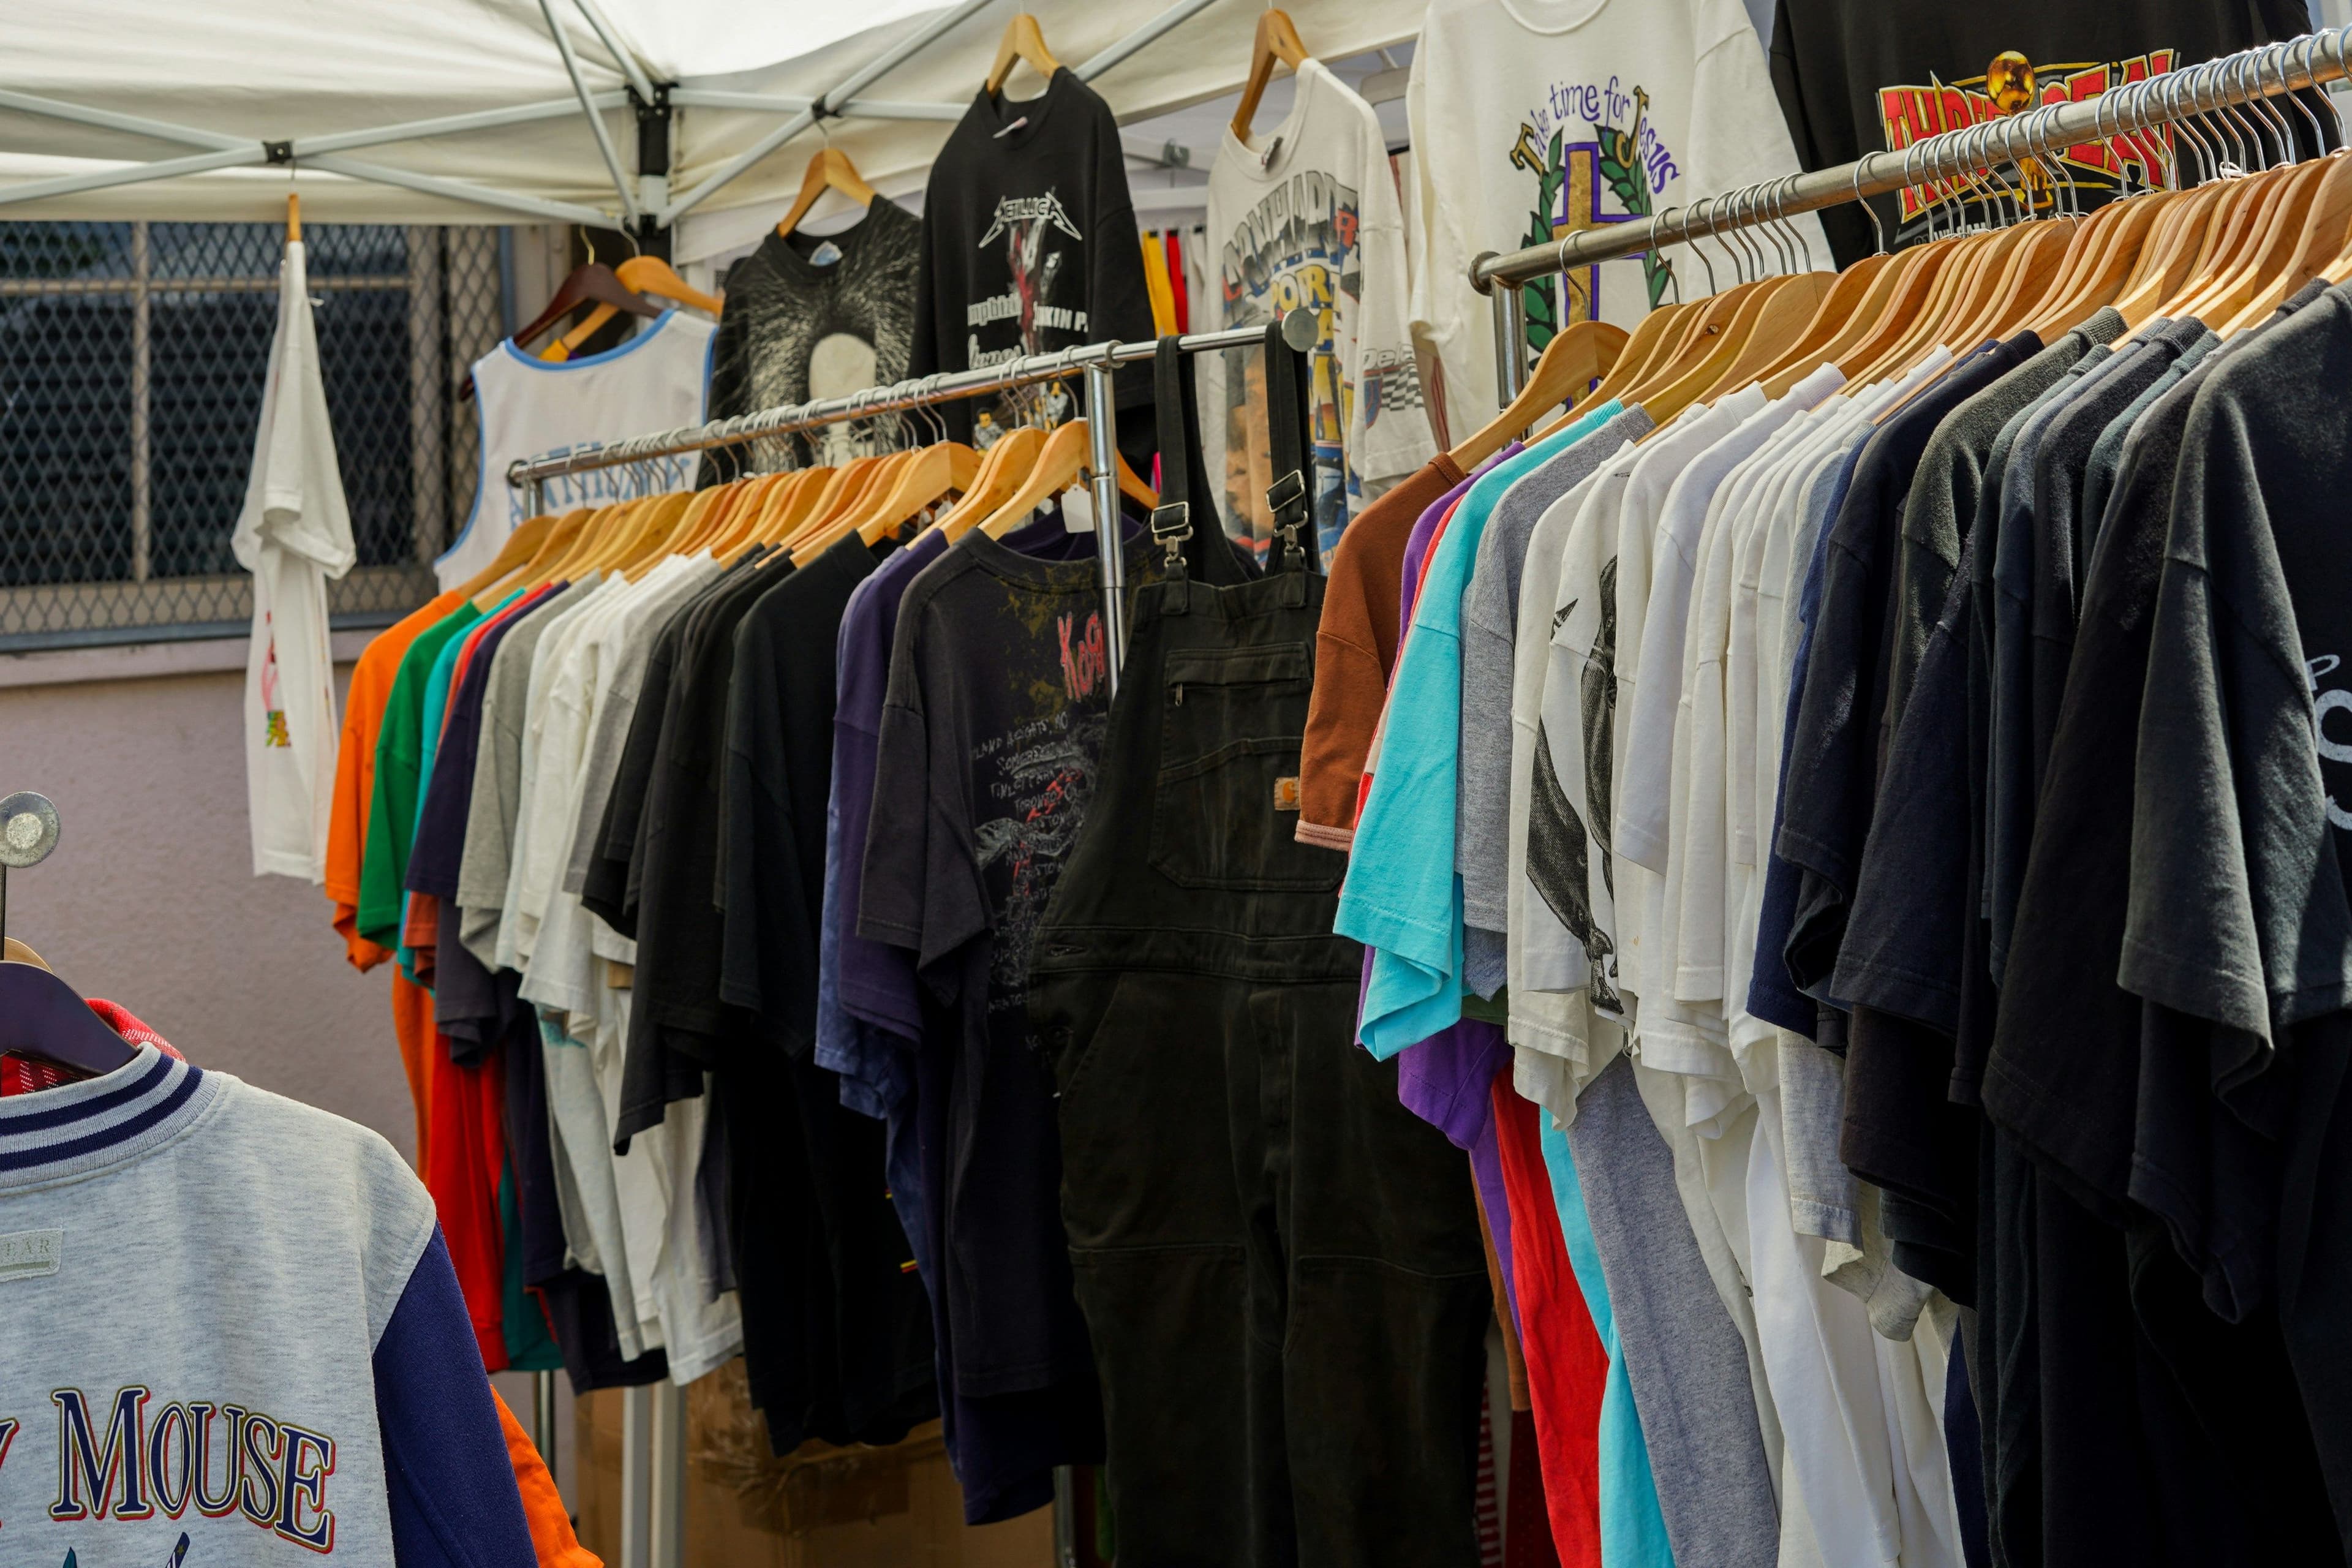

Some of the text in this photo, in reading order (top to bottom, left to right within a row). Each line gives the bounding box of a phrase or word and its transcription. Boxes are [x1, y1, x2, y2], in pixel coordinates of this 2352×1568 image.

[1550, 81, 1600, 121] time
[1602, 75, 1630, 141] for
[1615, 85, 1681, 194] Jesus
[48, 1385, 336, 1554] MOUSE
